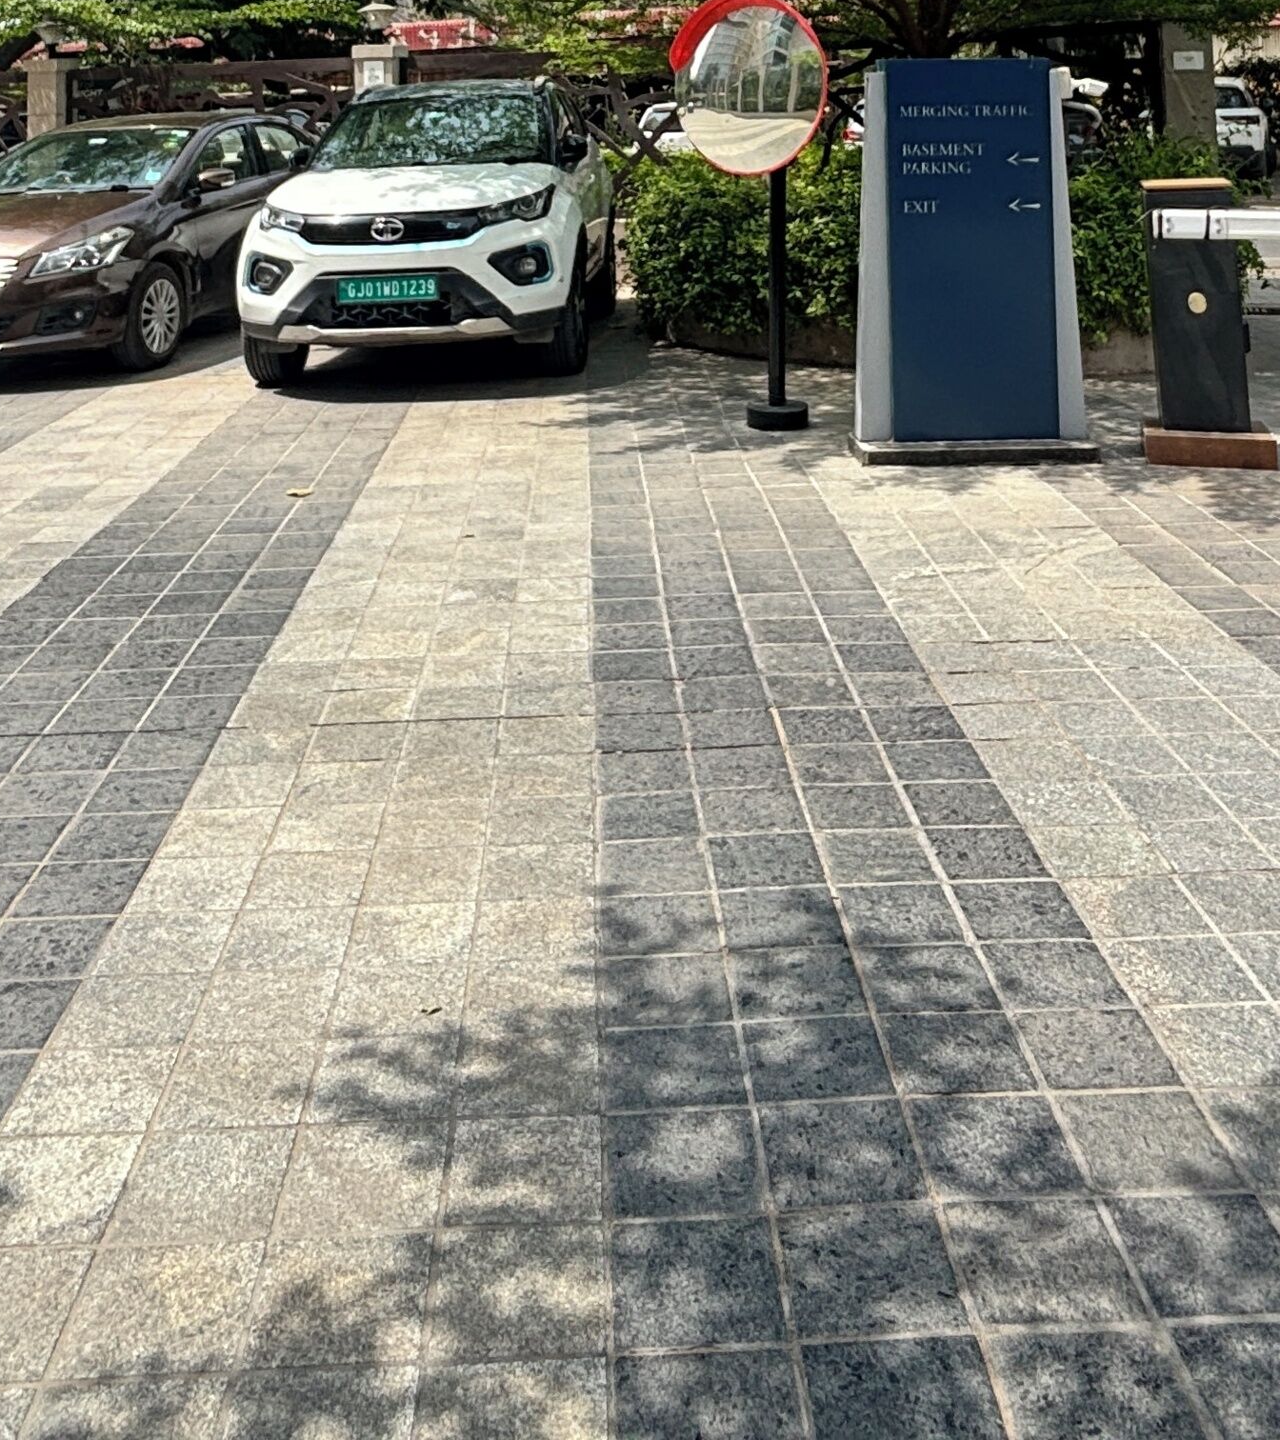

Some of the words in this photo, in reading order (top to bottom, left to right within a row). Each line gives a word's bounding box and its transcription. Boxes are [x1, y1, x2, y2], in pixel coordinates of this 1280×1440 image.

[900, 104, 970, 117] MERGING
[972, 104, 1033, 117] TRAFFIC
[902, 143, 986, 157] BASEMENT
[902, 161, 972, 175] PARKING
[904, 200, 940, 214] EXIT
[347, 278, 435, 298] GJ01WD1239
